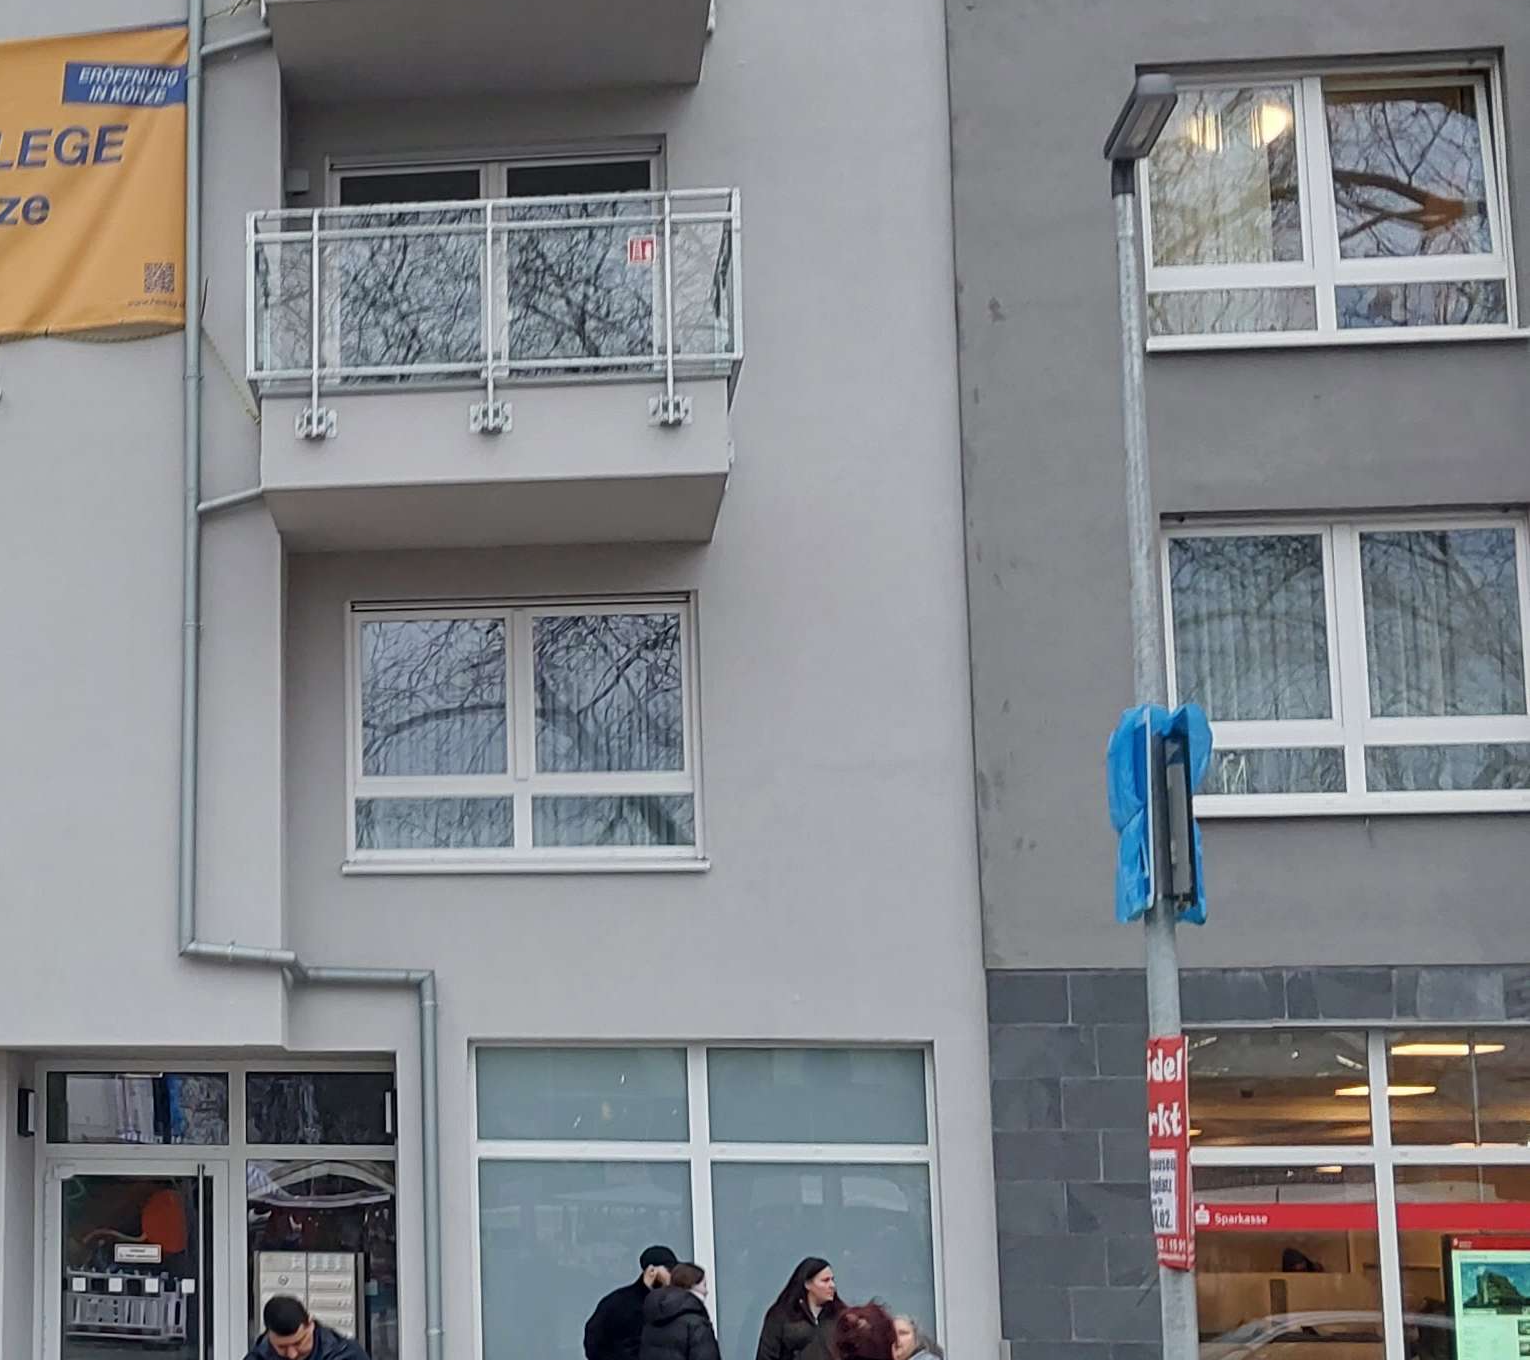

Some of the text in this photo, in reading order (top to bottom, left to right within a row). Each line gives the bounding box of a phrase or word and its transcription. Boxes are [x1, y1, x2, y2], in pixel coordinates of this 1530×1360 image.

[77, 64, 180, 87] ERÖFFNUNG
[88, 84, 108, 103] IN
[1214, 1213, 1269, 1226] Sparkasse
